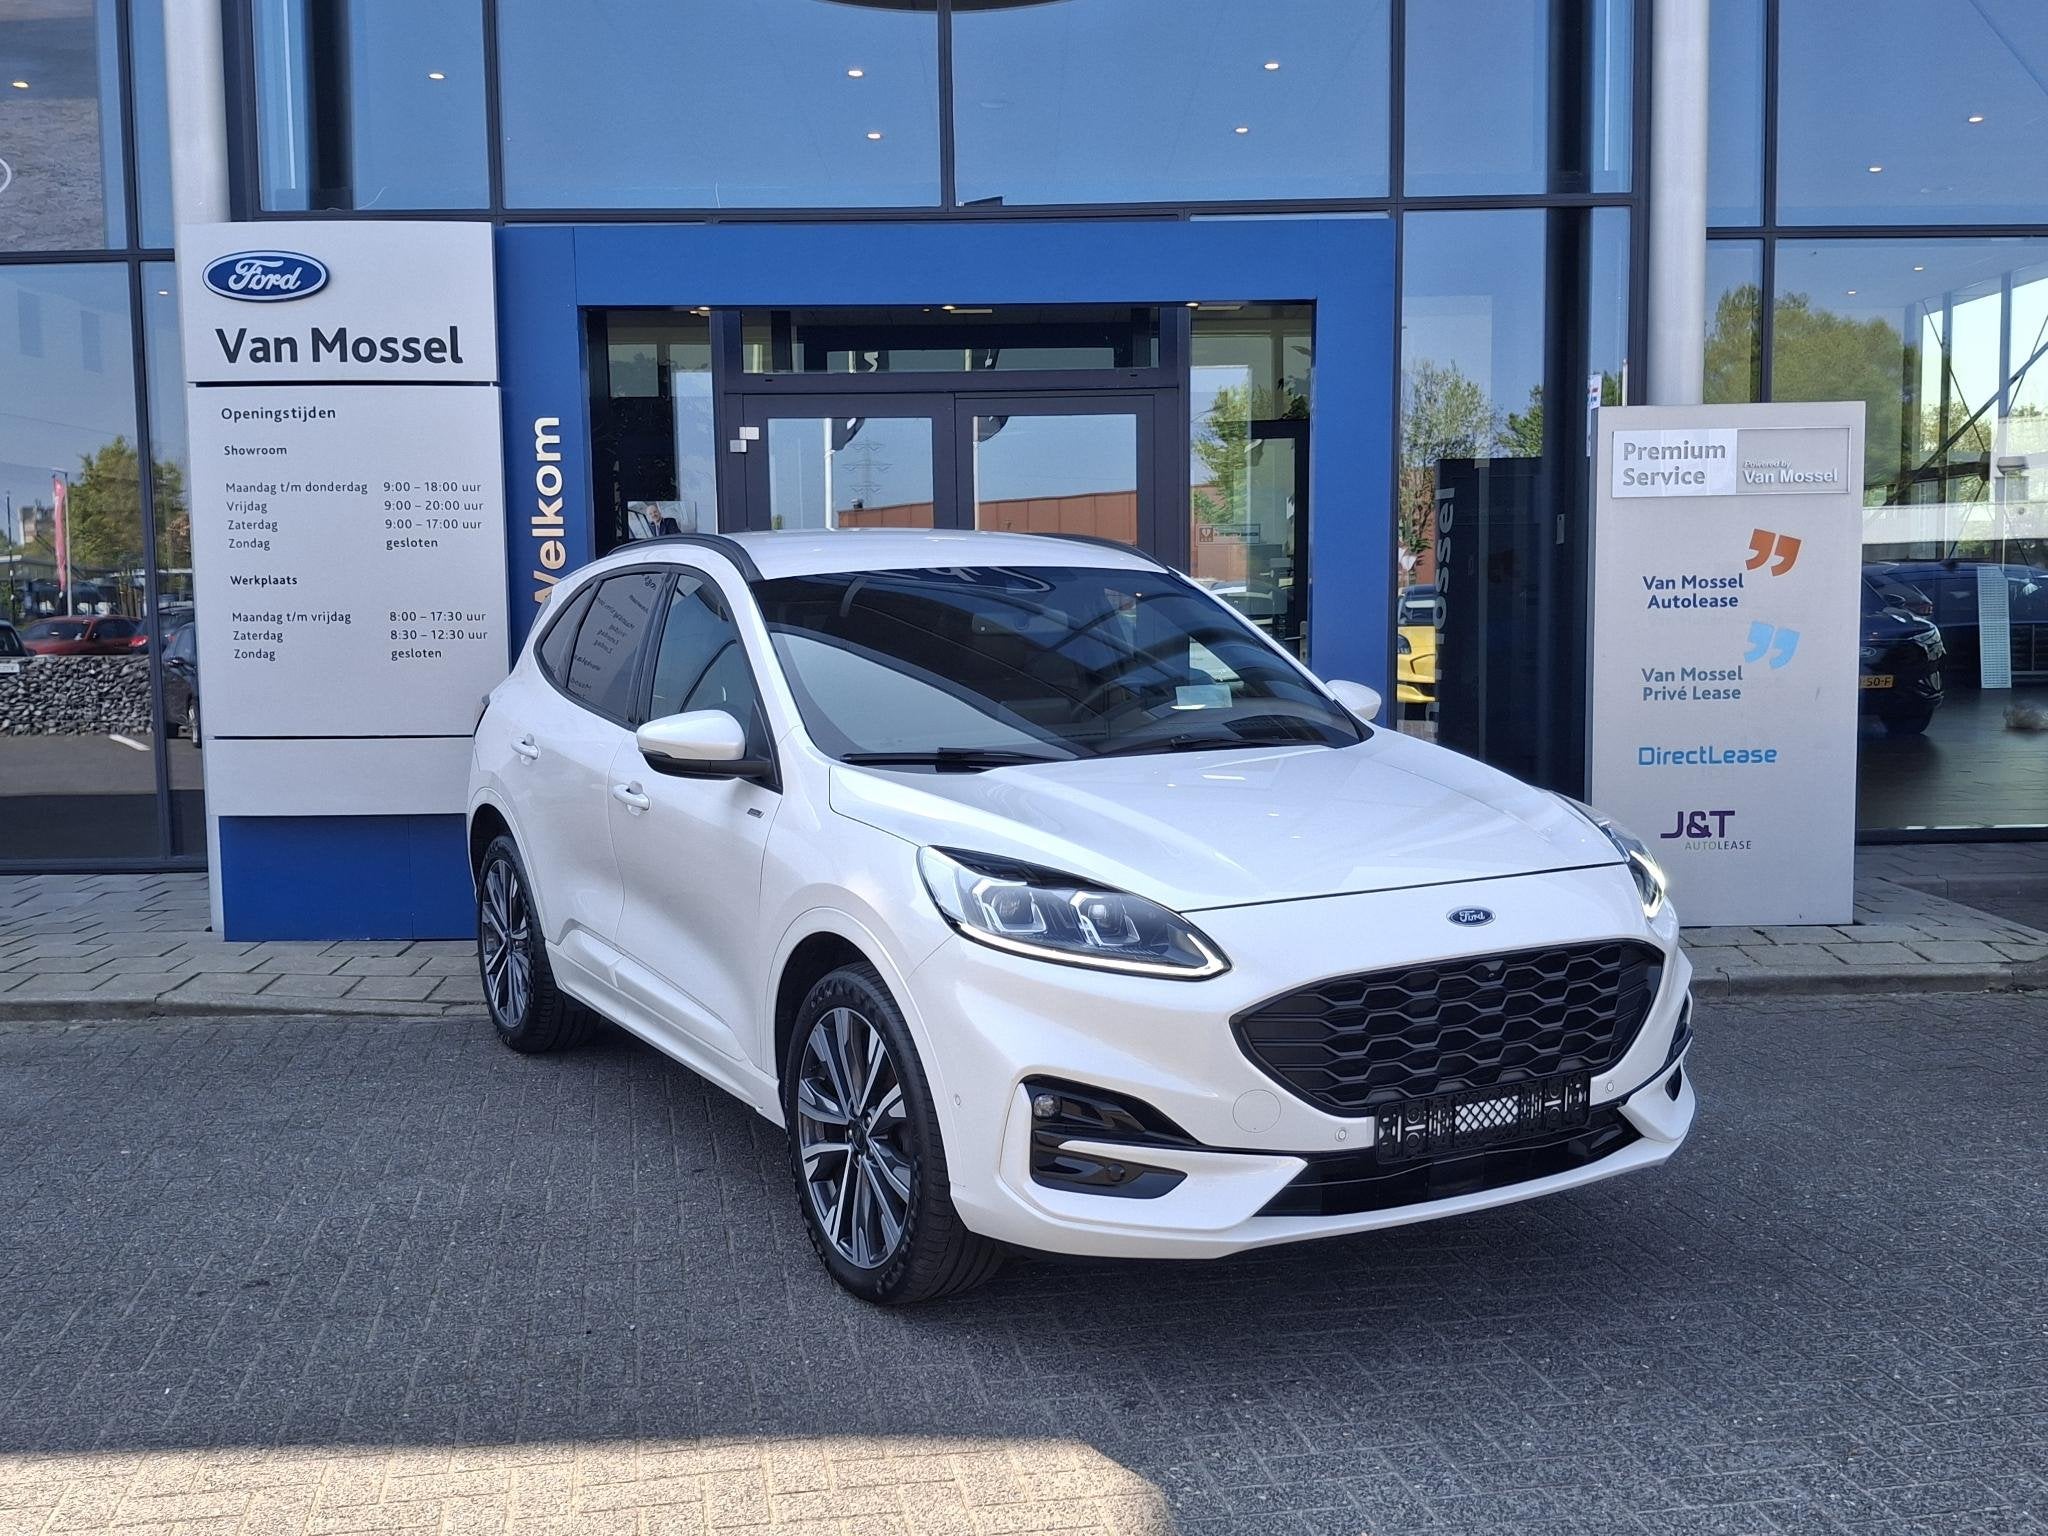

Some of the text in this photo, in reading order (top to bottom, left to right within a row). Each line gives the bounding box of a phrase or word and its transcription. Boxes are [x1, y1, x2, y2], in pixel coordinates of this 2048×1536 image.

[228, 259, 302, 290] Ford
[215, 326, 463, 363] Van Mossel
[222, 406, 335, 423] Openingstijden
[225, 445, 287, 455] Showroom
[1624, 440, 1727, 461] Premium
[1623, 466, 1706, 488] Service
[1742, 467, 1839, 485] Van Mossel
[226, 482, 276, 495] Maandag
[281, 482, 301, 492] t/m
[306, 482, 367, 494] donderdag
[384, 480, 410, 492] 9:00
[425, 482, 457, 492] 18:00
[227, 501, 267, 514] Vrijdag
[385, 500, 412, 511] 9:00
[426, 501, 459, 510] 20:00
[228, 519, 278, 532] Zaterdag
[385, 519, 412, 529] 9:00
[427, 519, 458, 528] 17:00
[229, 538, 437, 551] Zondag gesloten
[230, 575, 297, 588] Werkplaats
[1643, 573, 1744, 590] Van Mossel
[1648, 593, 1738, 609] Autolease
[233, 612, 283, 624] Maandag
[287, 612, 307, 622] t/m
[311, 611, 351, 624] vrijdag
[390, 612, 416, 622] 8:00
[431, 612, 462, 621] 17:30
[233, 630, 283, 643] Zaterdag
[391, 630, 417, 639] 8:30
[431, 630, 464, 640] 12:30
[235, 648, 441, 662] Zondag gesloten
[1641, 665, 1743, 682] Van Mossel
[1643, 686, 1741, 701] Privé Lease
[1639, 746, 1777, 765] DirectLease
[1661, 811, 1735, 838] J&T
[1685, 840, 1752, 851] AUTOLEASE
